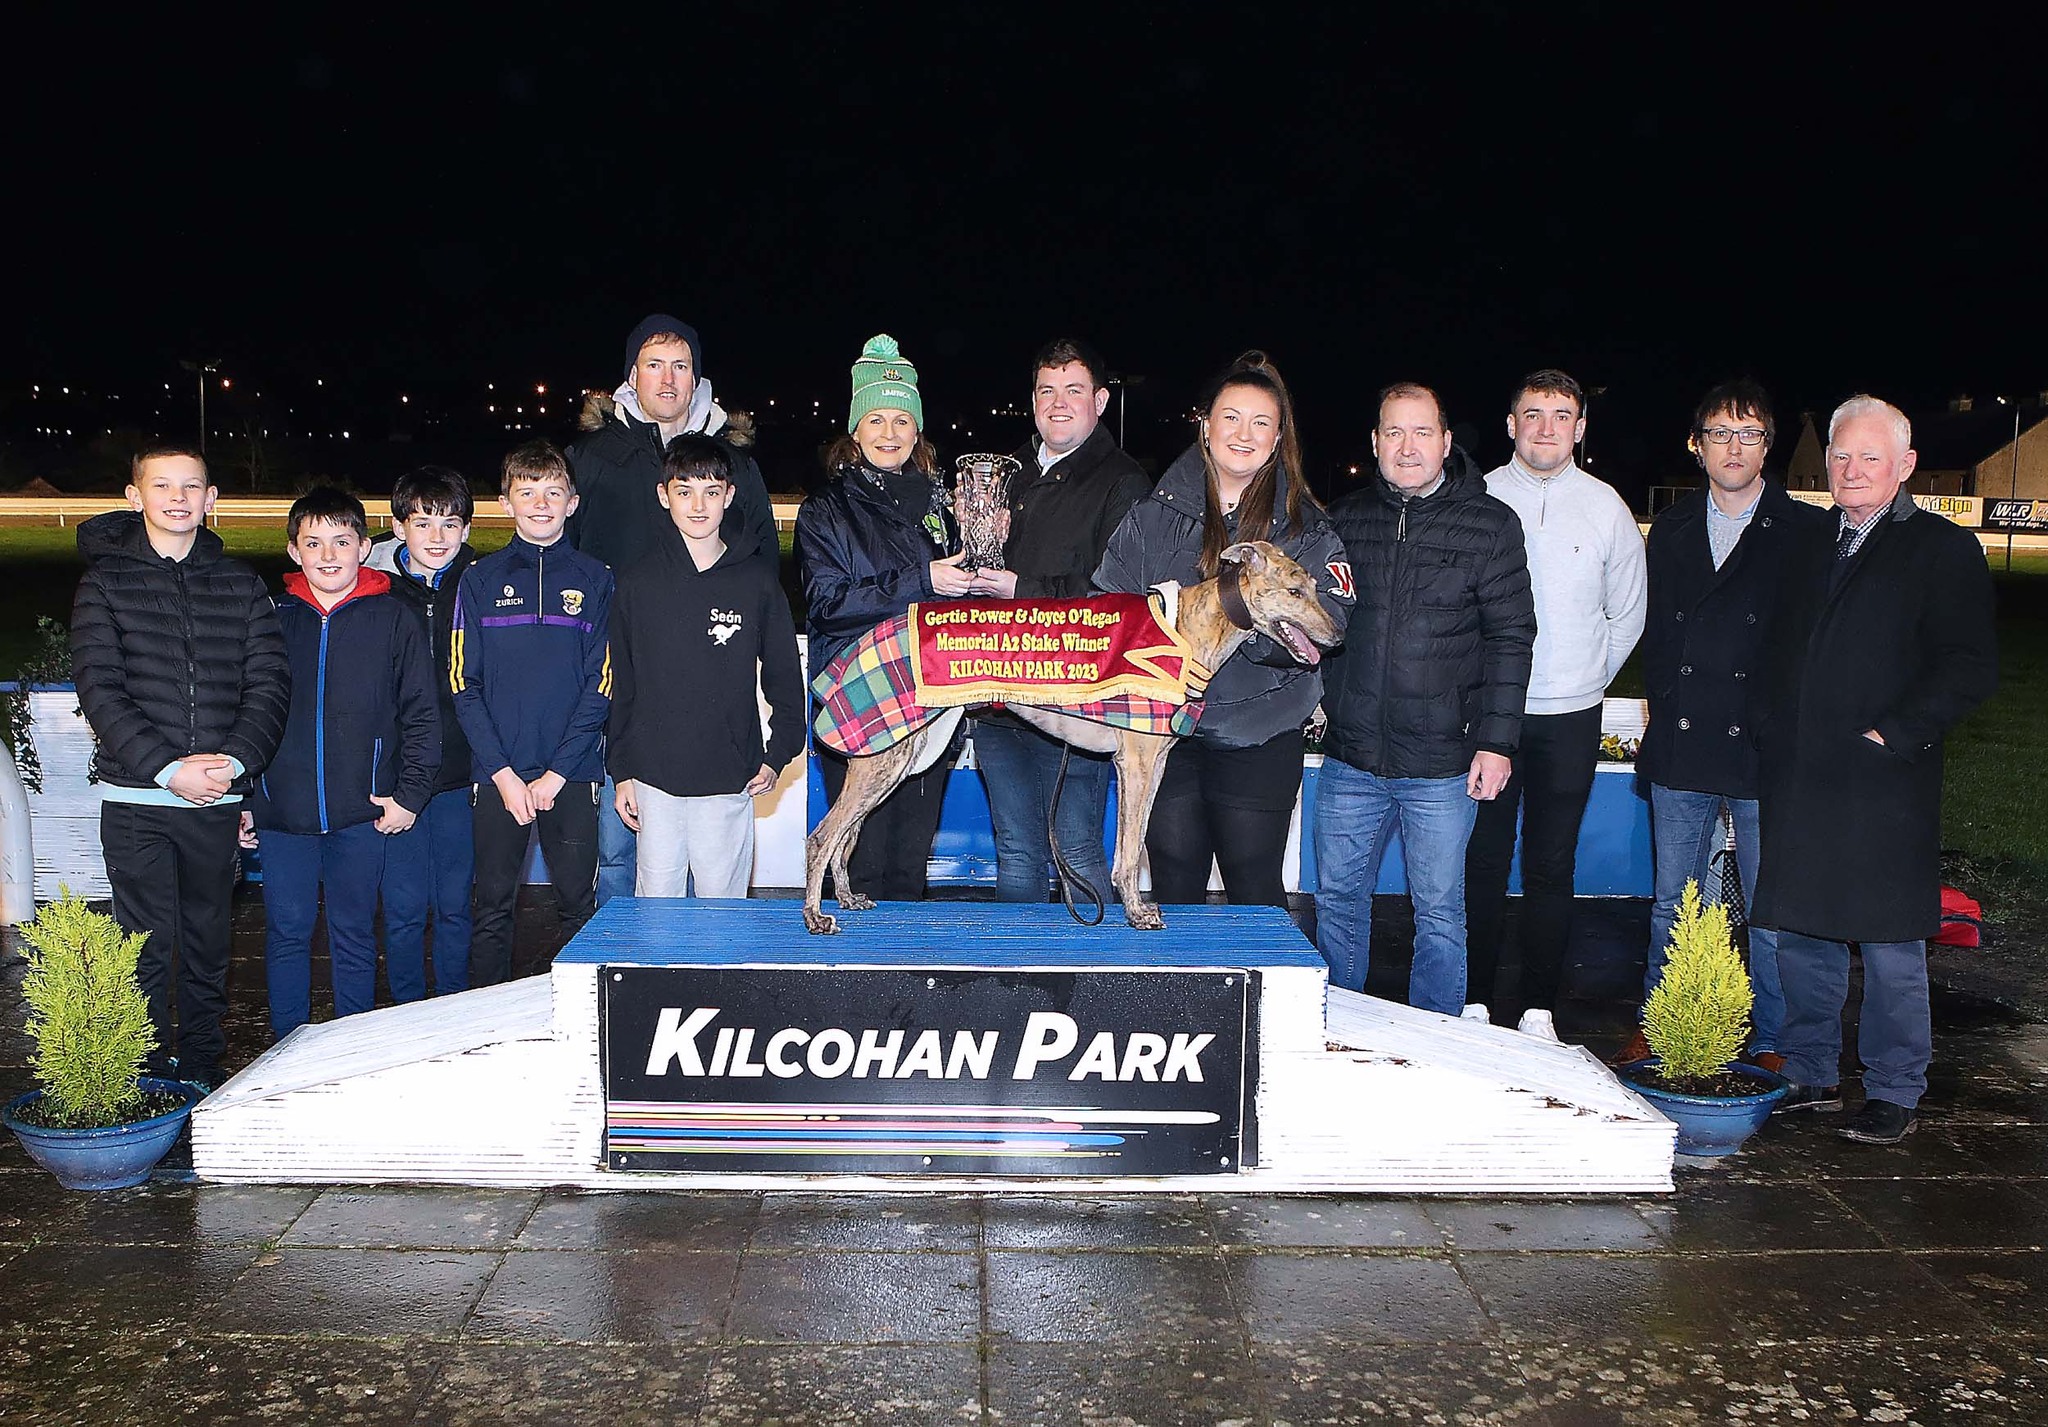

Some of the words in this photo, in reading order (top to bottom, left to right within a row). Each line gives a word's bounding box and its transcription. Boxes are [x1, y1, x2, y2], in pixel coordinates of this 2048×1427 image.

[1920, 496, 1972, 514] AdSign
[495, 598, 524, 607] ZURICH
[710, 608, 742, 624] Seán
[925, 609, 967, 626] Gertie
[969, 609, 1013, 624] Power
[1014, 608, 1028, 622] &
[1029, 608, 1066, 628] Joyce
[1068, 608, 1120, 628] O'Regan
[936, 633, 999, 652] Memorial
[1001, 635, 1020, 652] A2
[1021, 633, 1060, 652] Stake
[1061, 633, 1110, 652] Winner
[949, 658, 1024, 679] KILCOHAN
[1025, 661, 1066, 679] PARK
[1067, 663, 1099, 681] 2023
[645, 1007, 999, 1080] KILCOHAN
[1012, 1011, 1217, 1082] PARK
